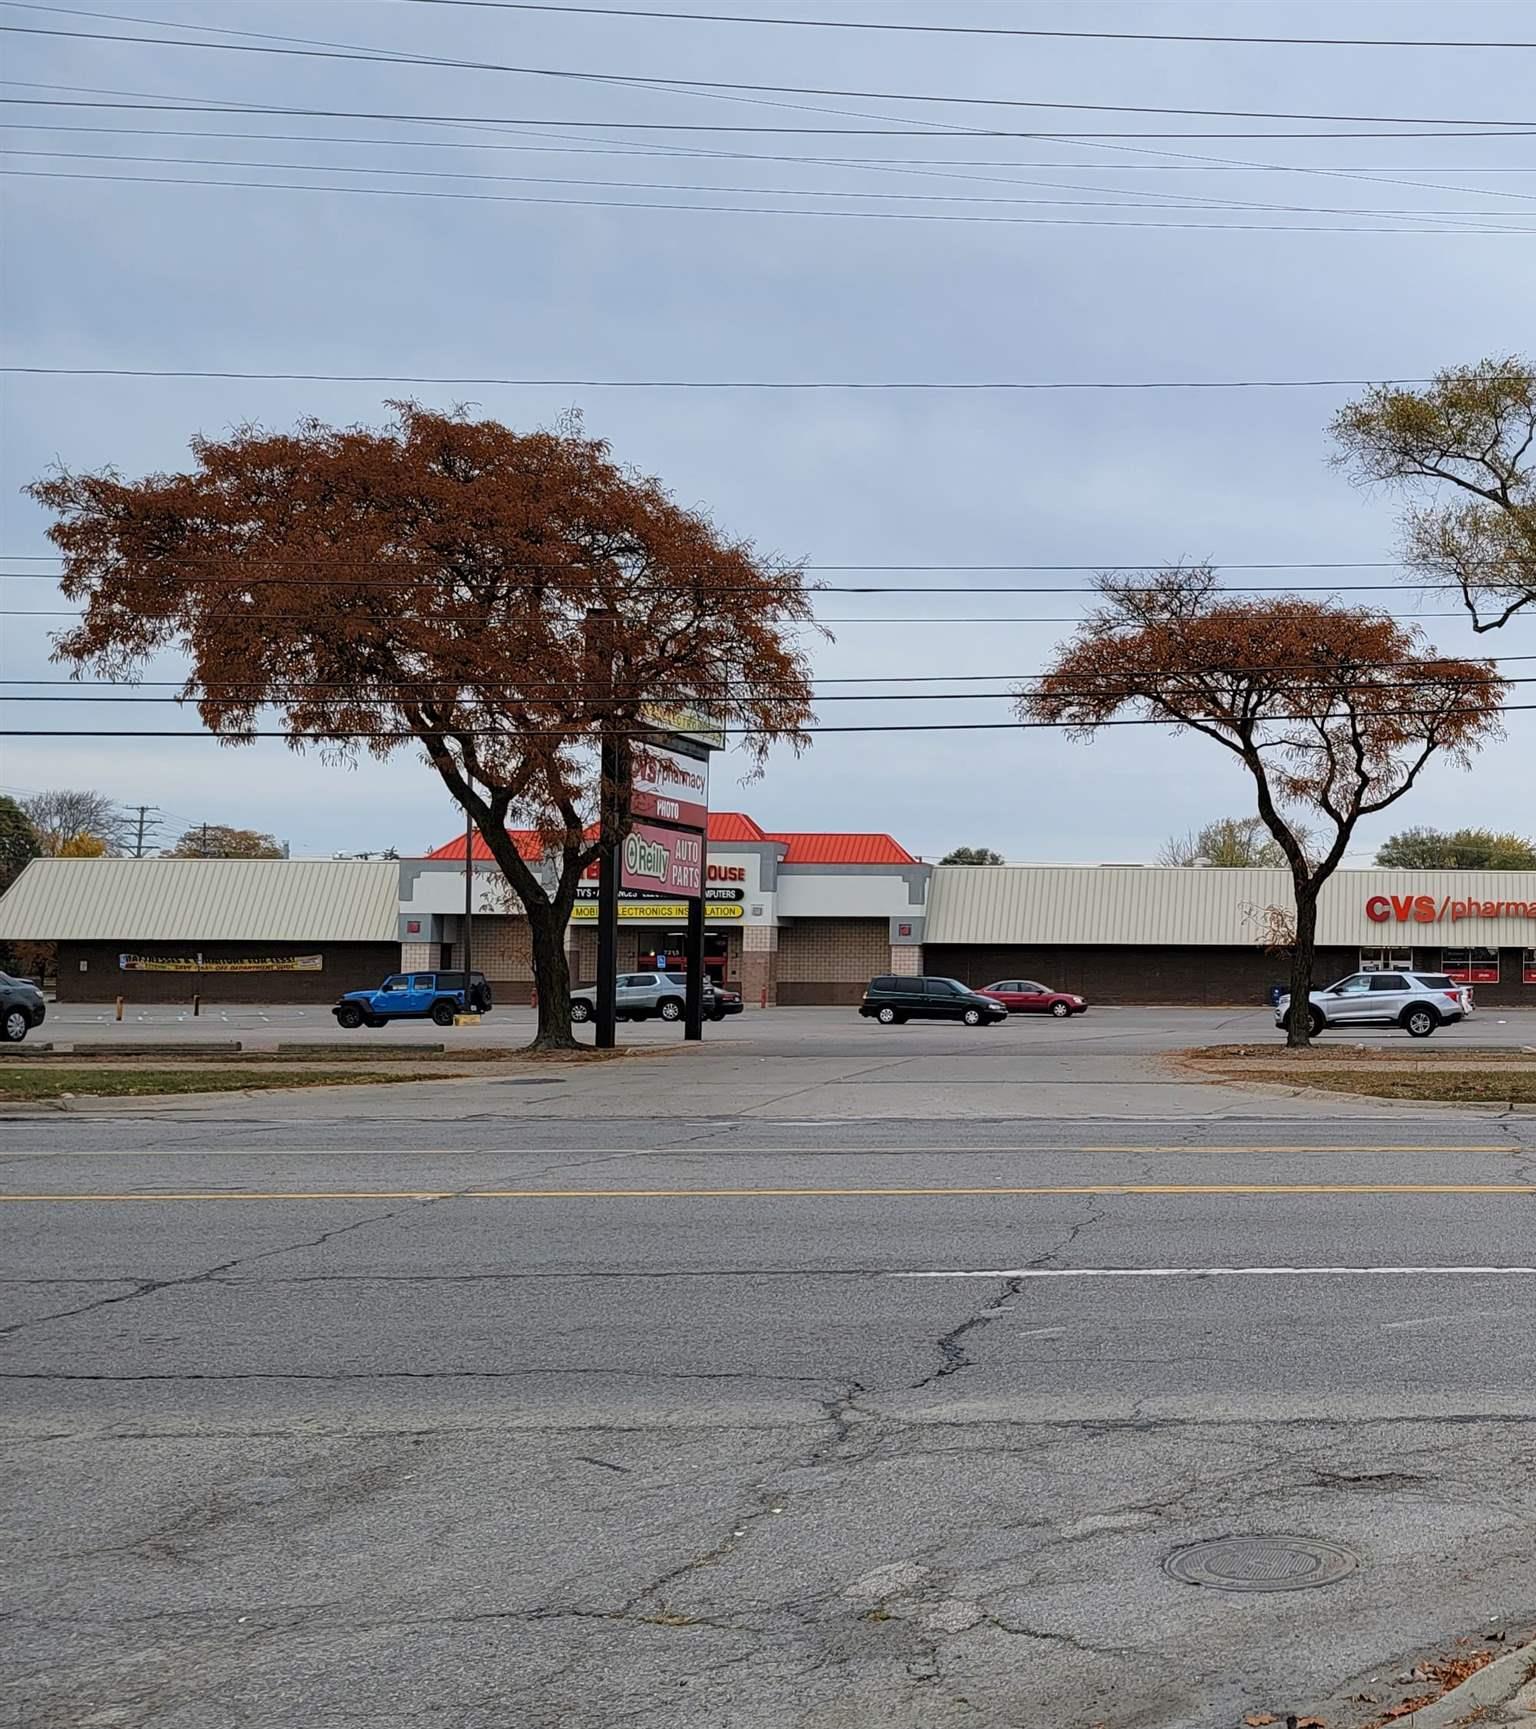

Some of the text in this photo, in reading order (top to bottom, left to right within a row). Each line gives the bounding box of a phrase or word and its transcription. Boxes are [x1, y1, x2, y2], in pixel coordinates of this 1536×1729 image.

[656, 799, 680, 820] PHOTO
[675, 839, 699, 863] AUTO
[672, 865, 700, 889] PARTS
